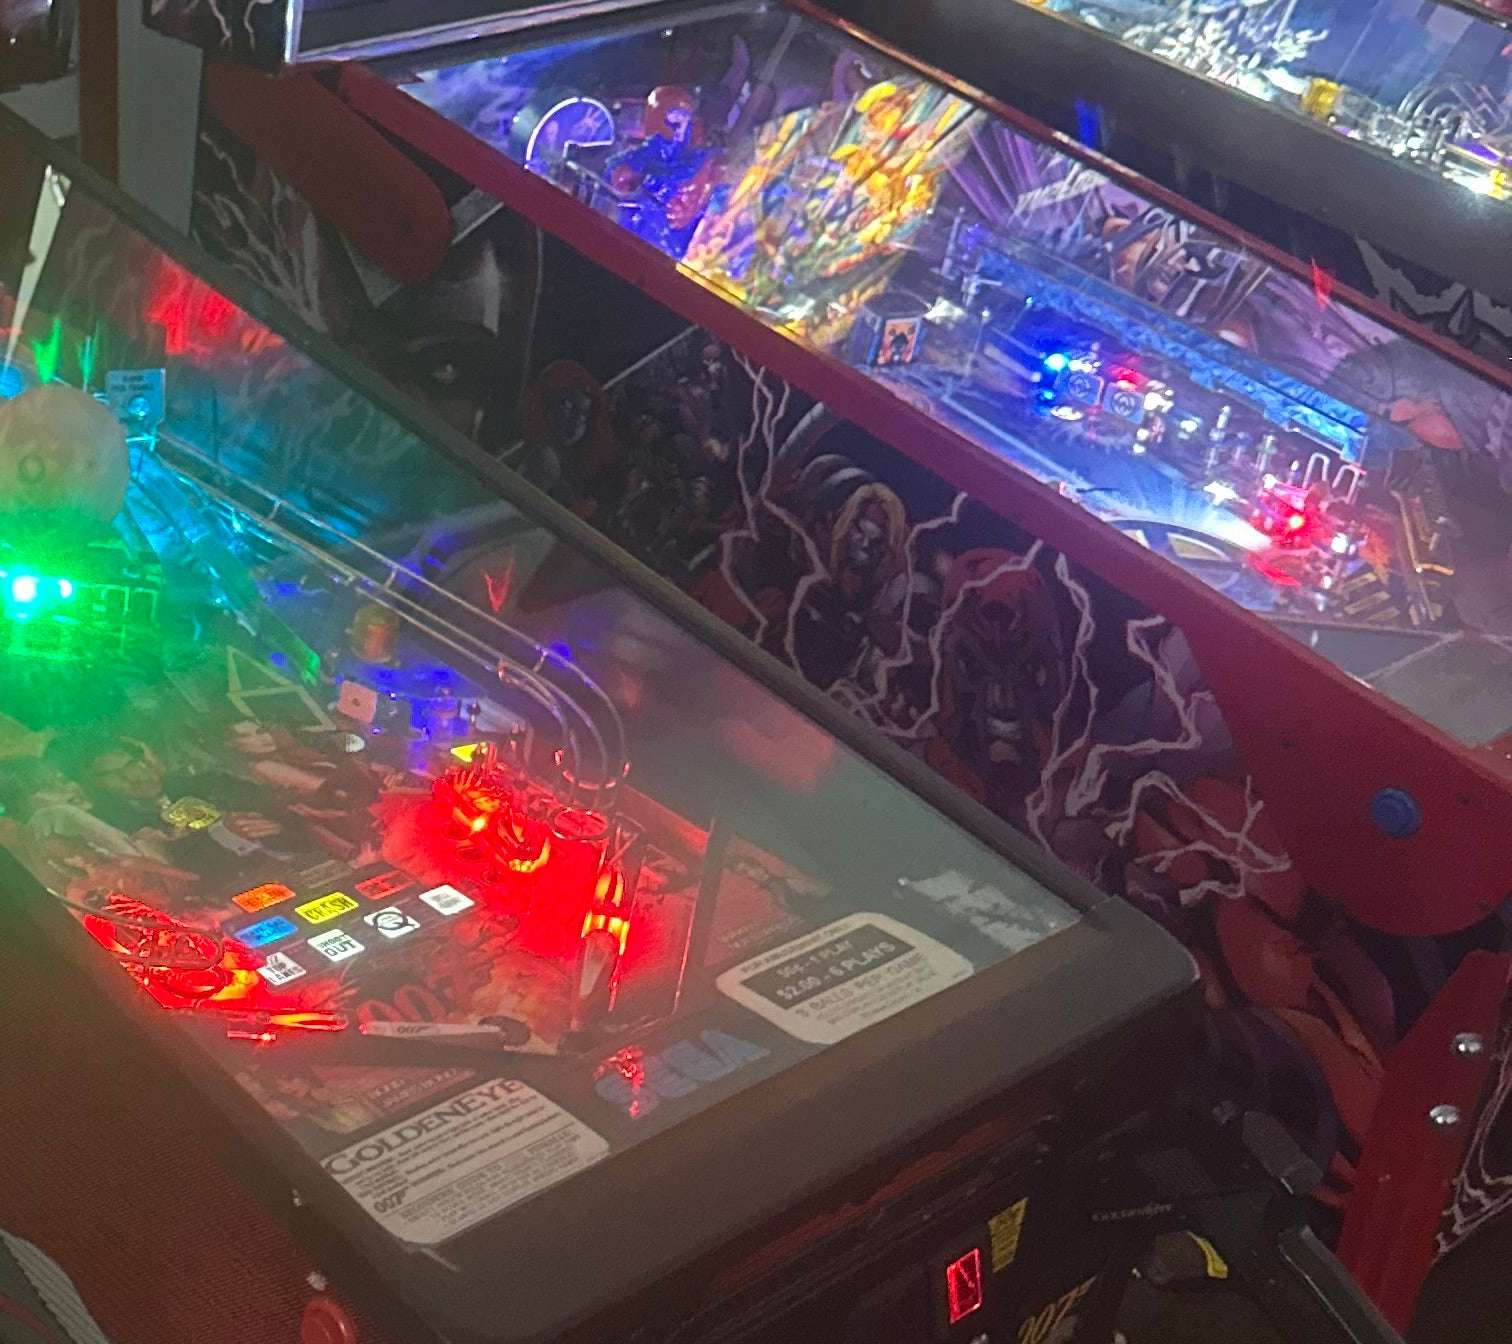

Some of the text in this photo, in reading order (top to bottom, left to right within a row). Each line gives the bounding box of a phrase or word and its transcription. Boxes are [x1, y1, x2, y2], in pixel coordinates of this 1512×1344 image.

[303, 896, 355, 921] CRASH
[324, 939, 357, 957] OUT
[840, 940, 897, 972] PLAYS
[324, 1077, 526, 1176] GOLDENEYE
